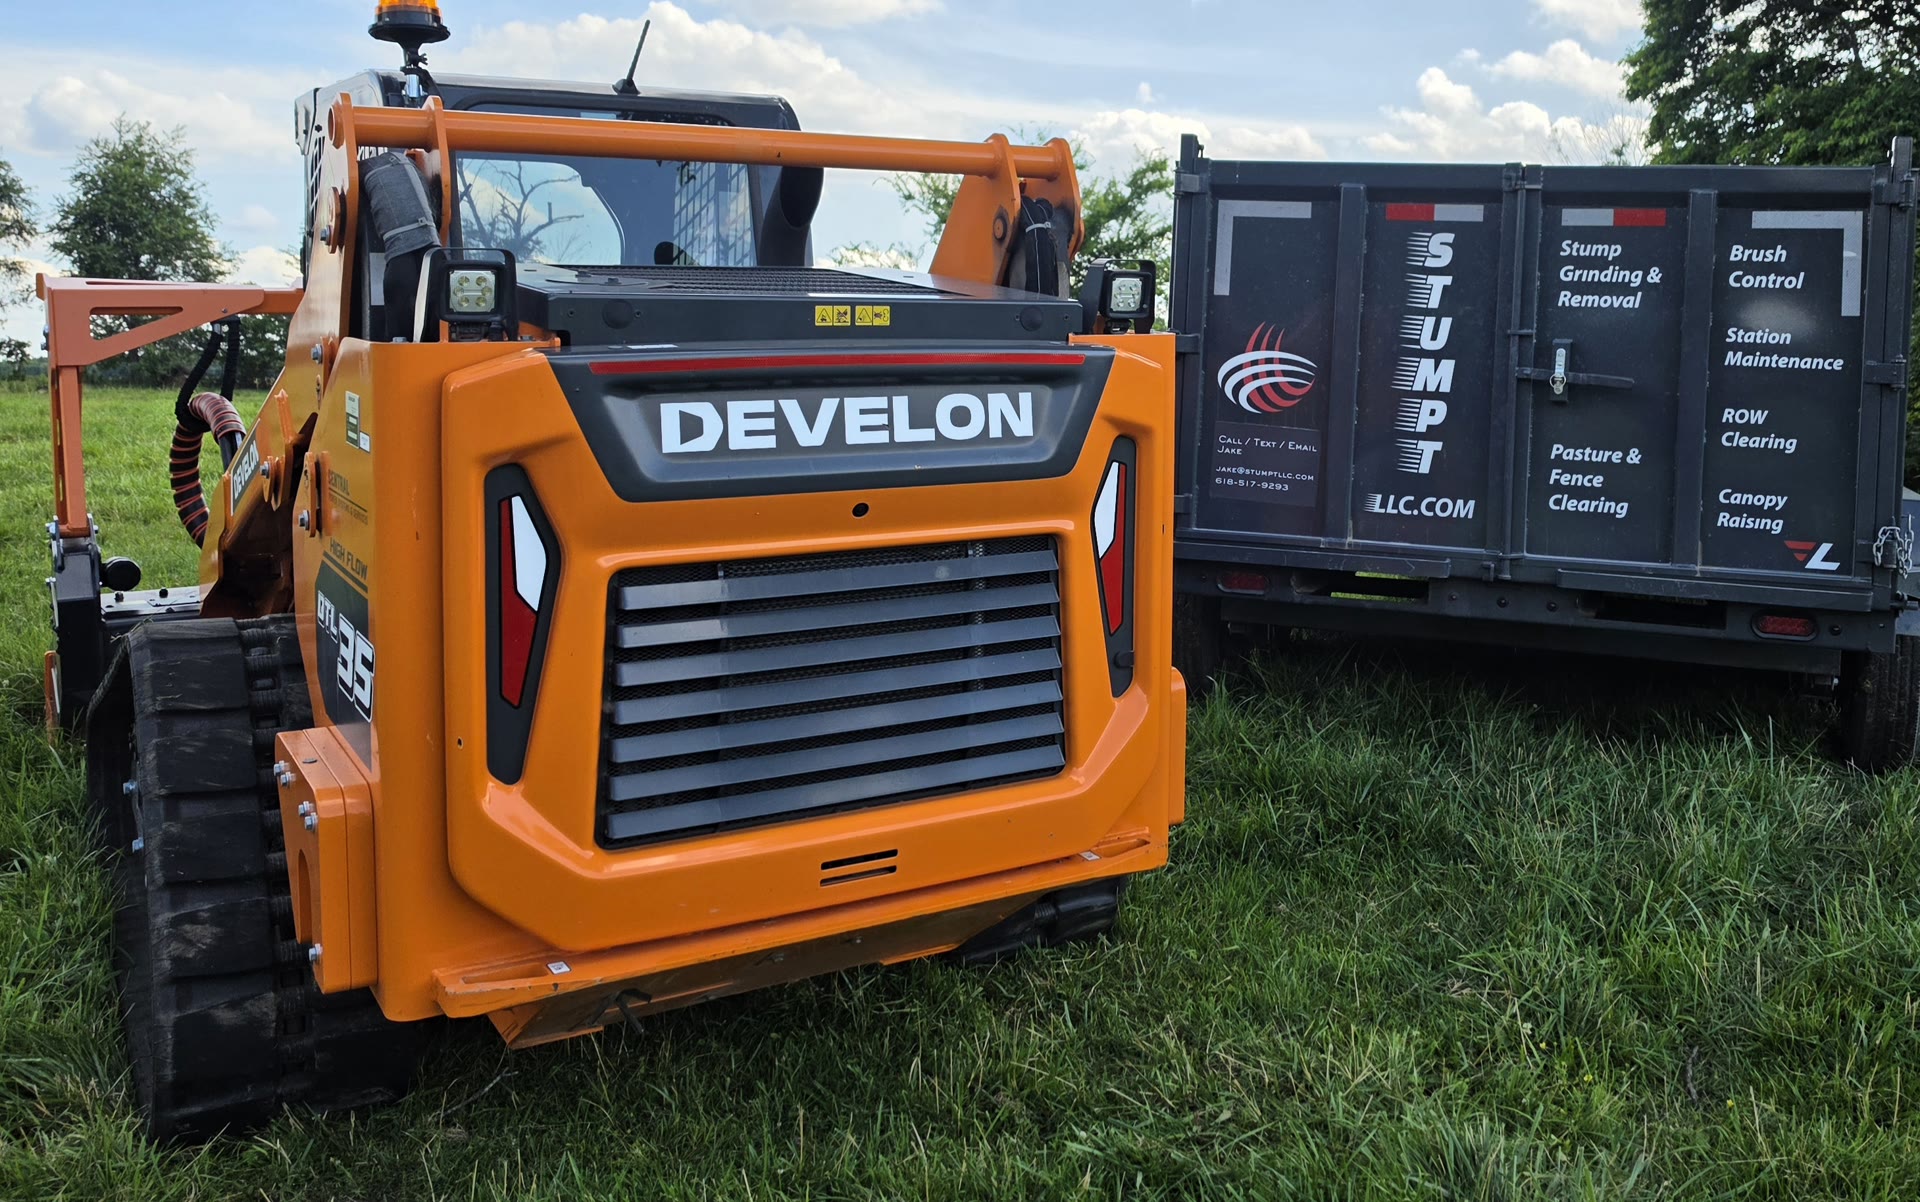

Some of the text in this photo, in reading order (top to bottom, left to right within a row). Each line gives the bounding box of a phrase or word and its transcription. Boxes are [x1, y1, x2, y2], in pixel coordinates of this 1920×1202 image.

[1560, 240, 1622, 261] Stump
[1729, 244, 1787, 262] Brush
[1559, 265, 1663, 287] Grinding &
[1728, 270, 1805, 289] Control
[1558, 290, 1642, 308] Removal
[1725, 327, 1792, 344] Station
[1393, 232, 1456, 474] STUMPT
[1724, 351, 1844, 370] Maintenance
[660, 391, 1034, 453] DEVELON
[1721, 408, 1768, 424] ROW
[1550, 443, 1642, 464] Pasture &
[1721, 432, 1797, 454] Clearing
[1215, 477, 1289, 491] 618-517-9293
[1549, 468, 1604, 487] Fence
[1364, 494, 1476, 519] LLC.COM
[1548, 493, 1629, 519] Clearing
[1718, 488, 1788, 511] Canopy
[1717, 511, 1784, 534] Raising
[329, 537, 368, 580] HIGH FLOW
[317, 590, 376, 723] DTL 35
